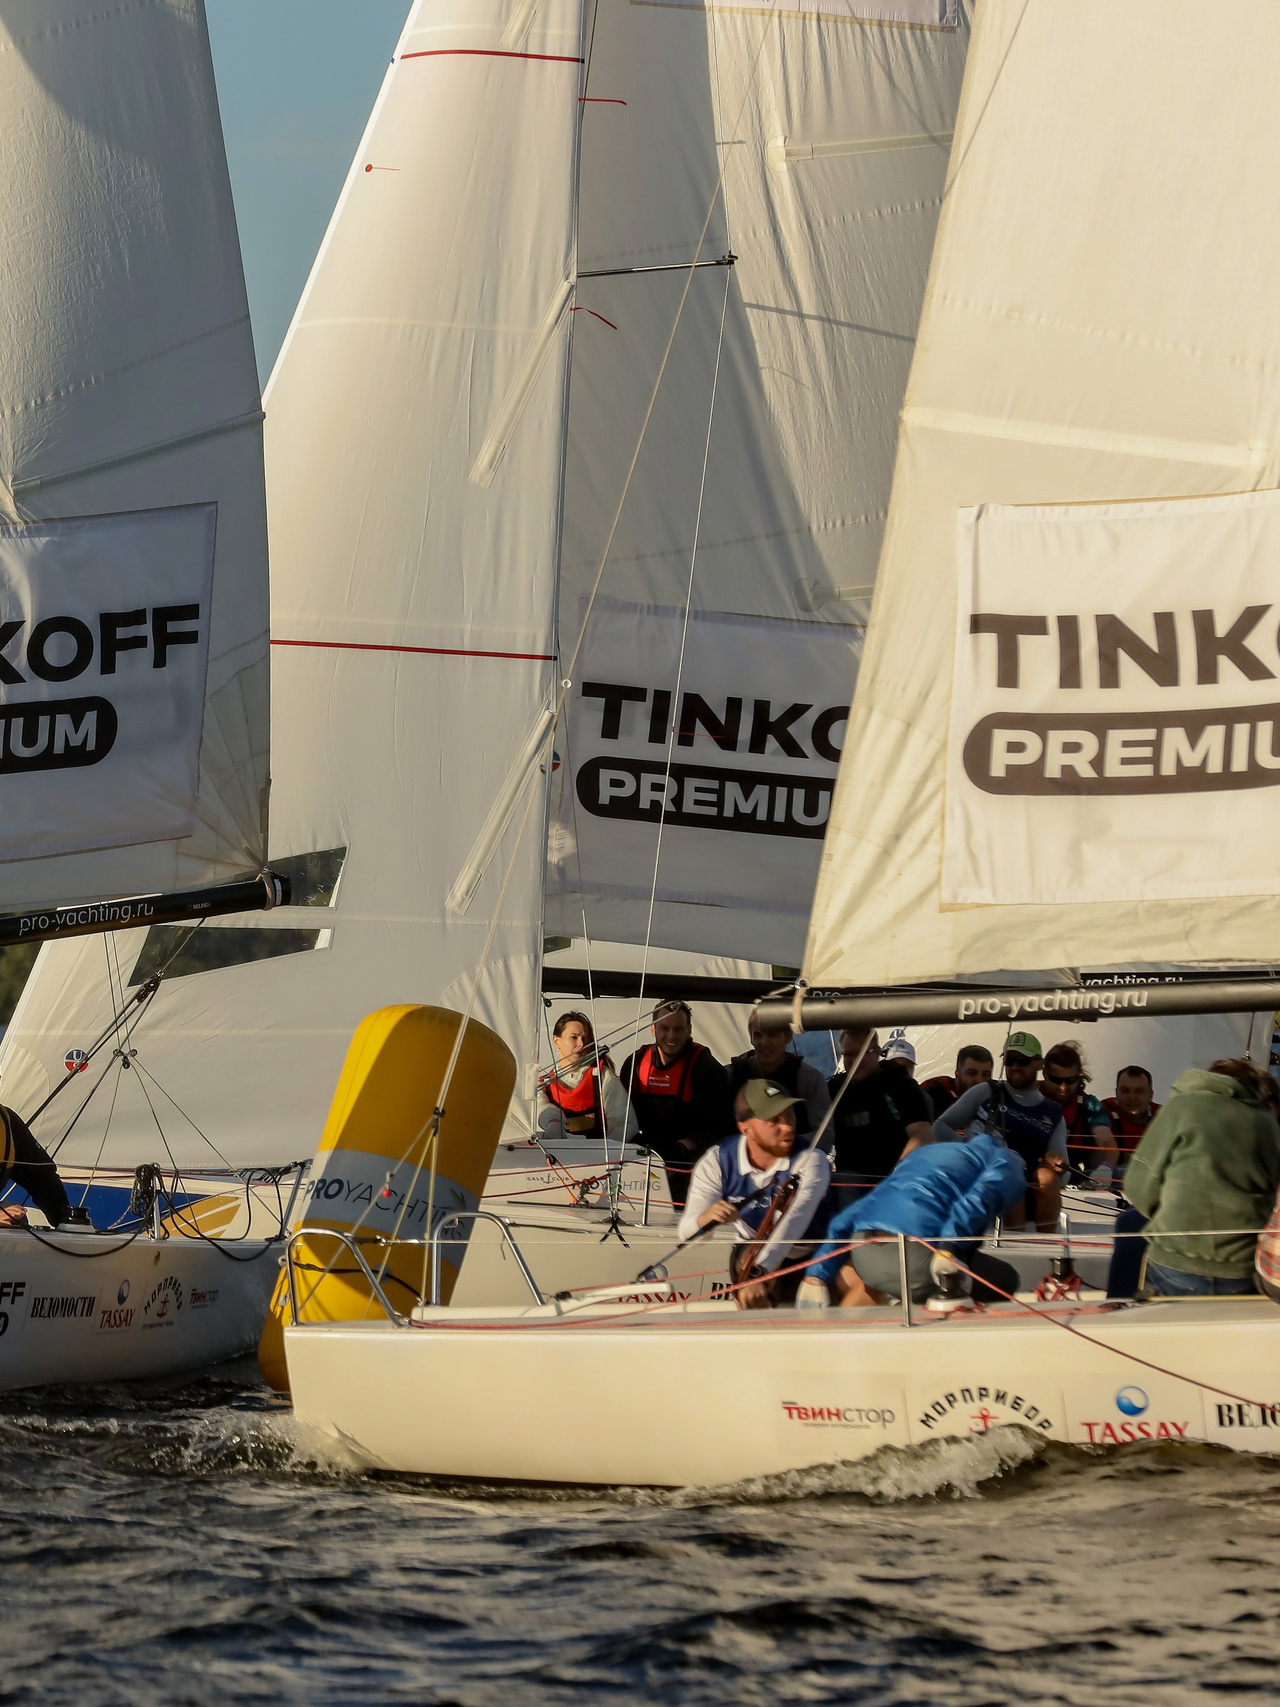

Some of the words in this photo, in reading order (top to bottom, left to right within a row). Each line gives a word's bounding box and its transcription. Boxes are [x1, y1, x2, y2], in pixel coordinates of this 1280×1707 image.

[969, 604, 1280, 690] TINK
[19, 901, 154, 936] pro-yachting.ru
[957, 988, 1148, 1020] pro-yachting.ru
[30, 1296, 96, 1319] ВЕДОМОСТИ
[99, 1308, 136, 1329] TASSAY
[919, 1387, 1054, 1431] МОРПРИБОР
